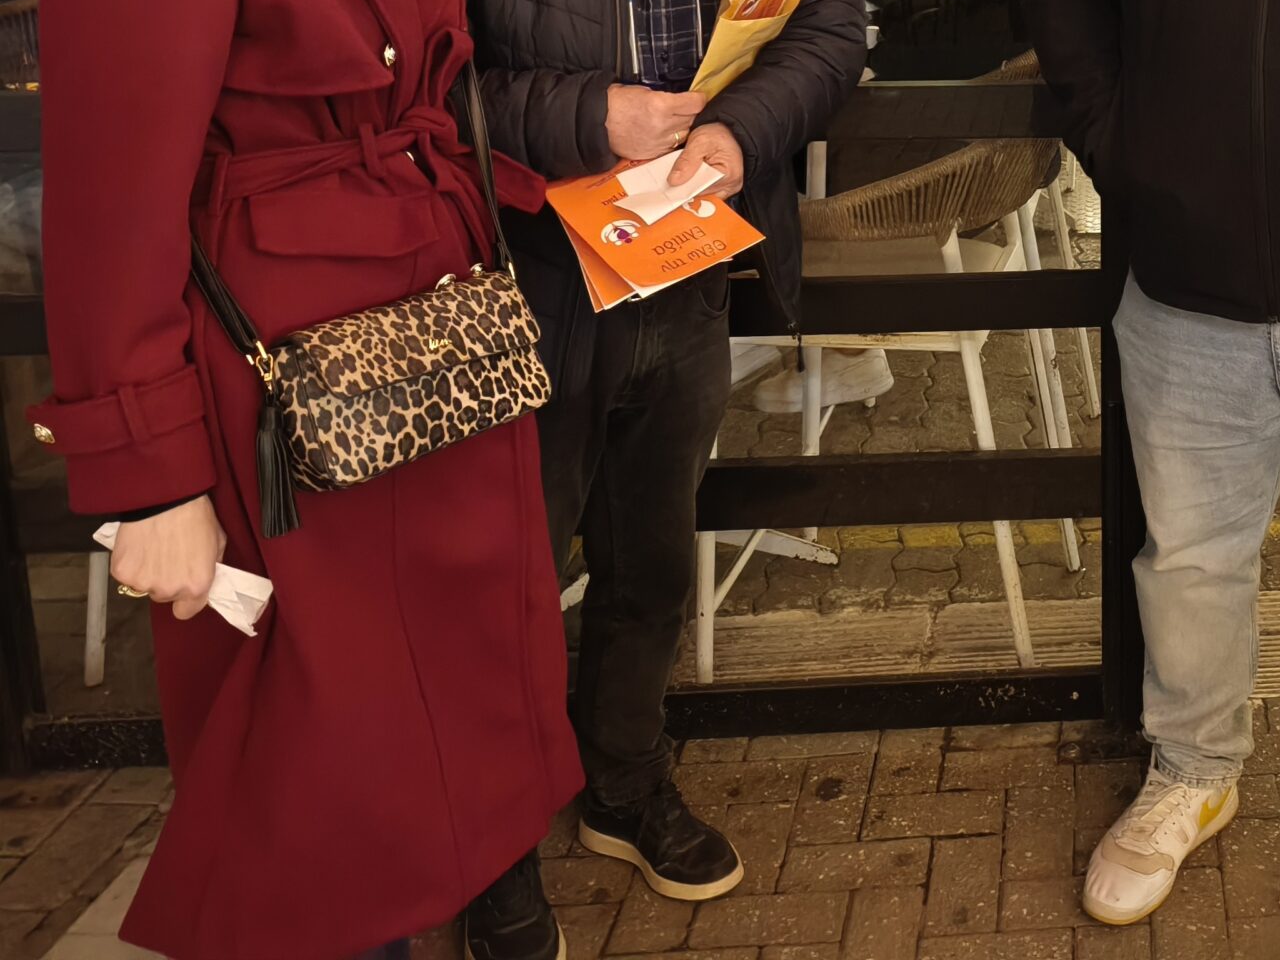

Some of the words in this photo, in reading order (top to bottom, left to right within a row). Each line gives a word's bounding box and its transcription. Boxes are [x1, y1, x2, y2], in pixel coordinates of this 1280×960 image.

[652, 225, 706, 256] Ελπίδα
[687, 239, 727, 261] Θέλω
[661, 258, 687, 273] την
